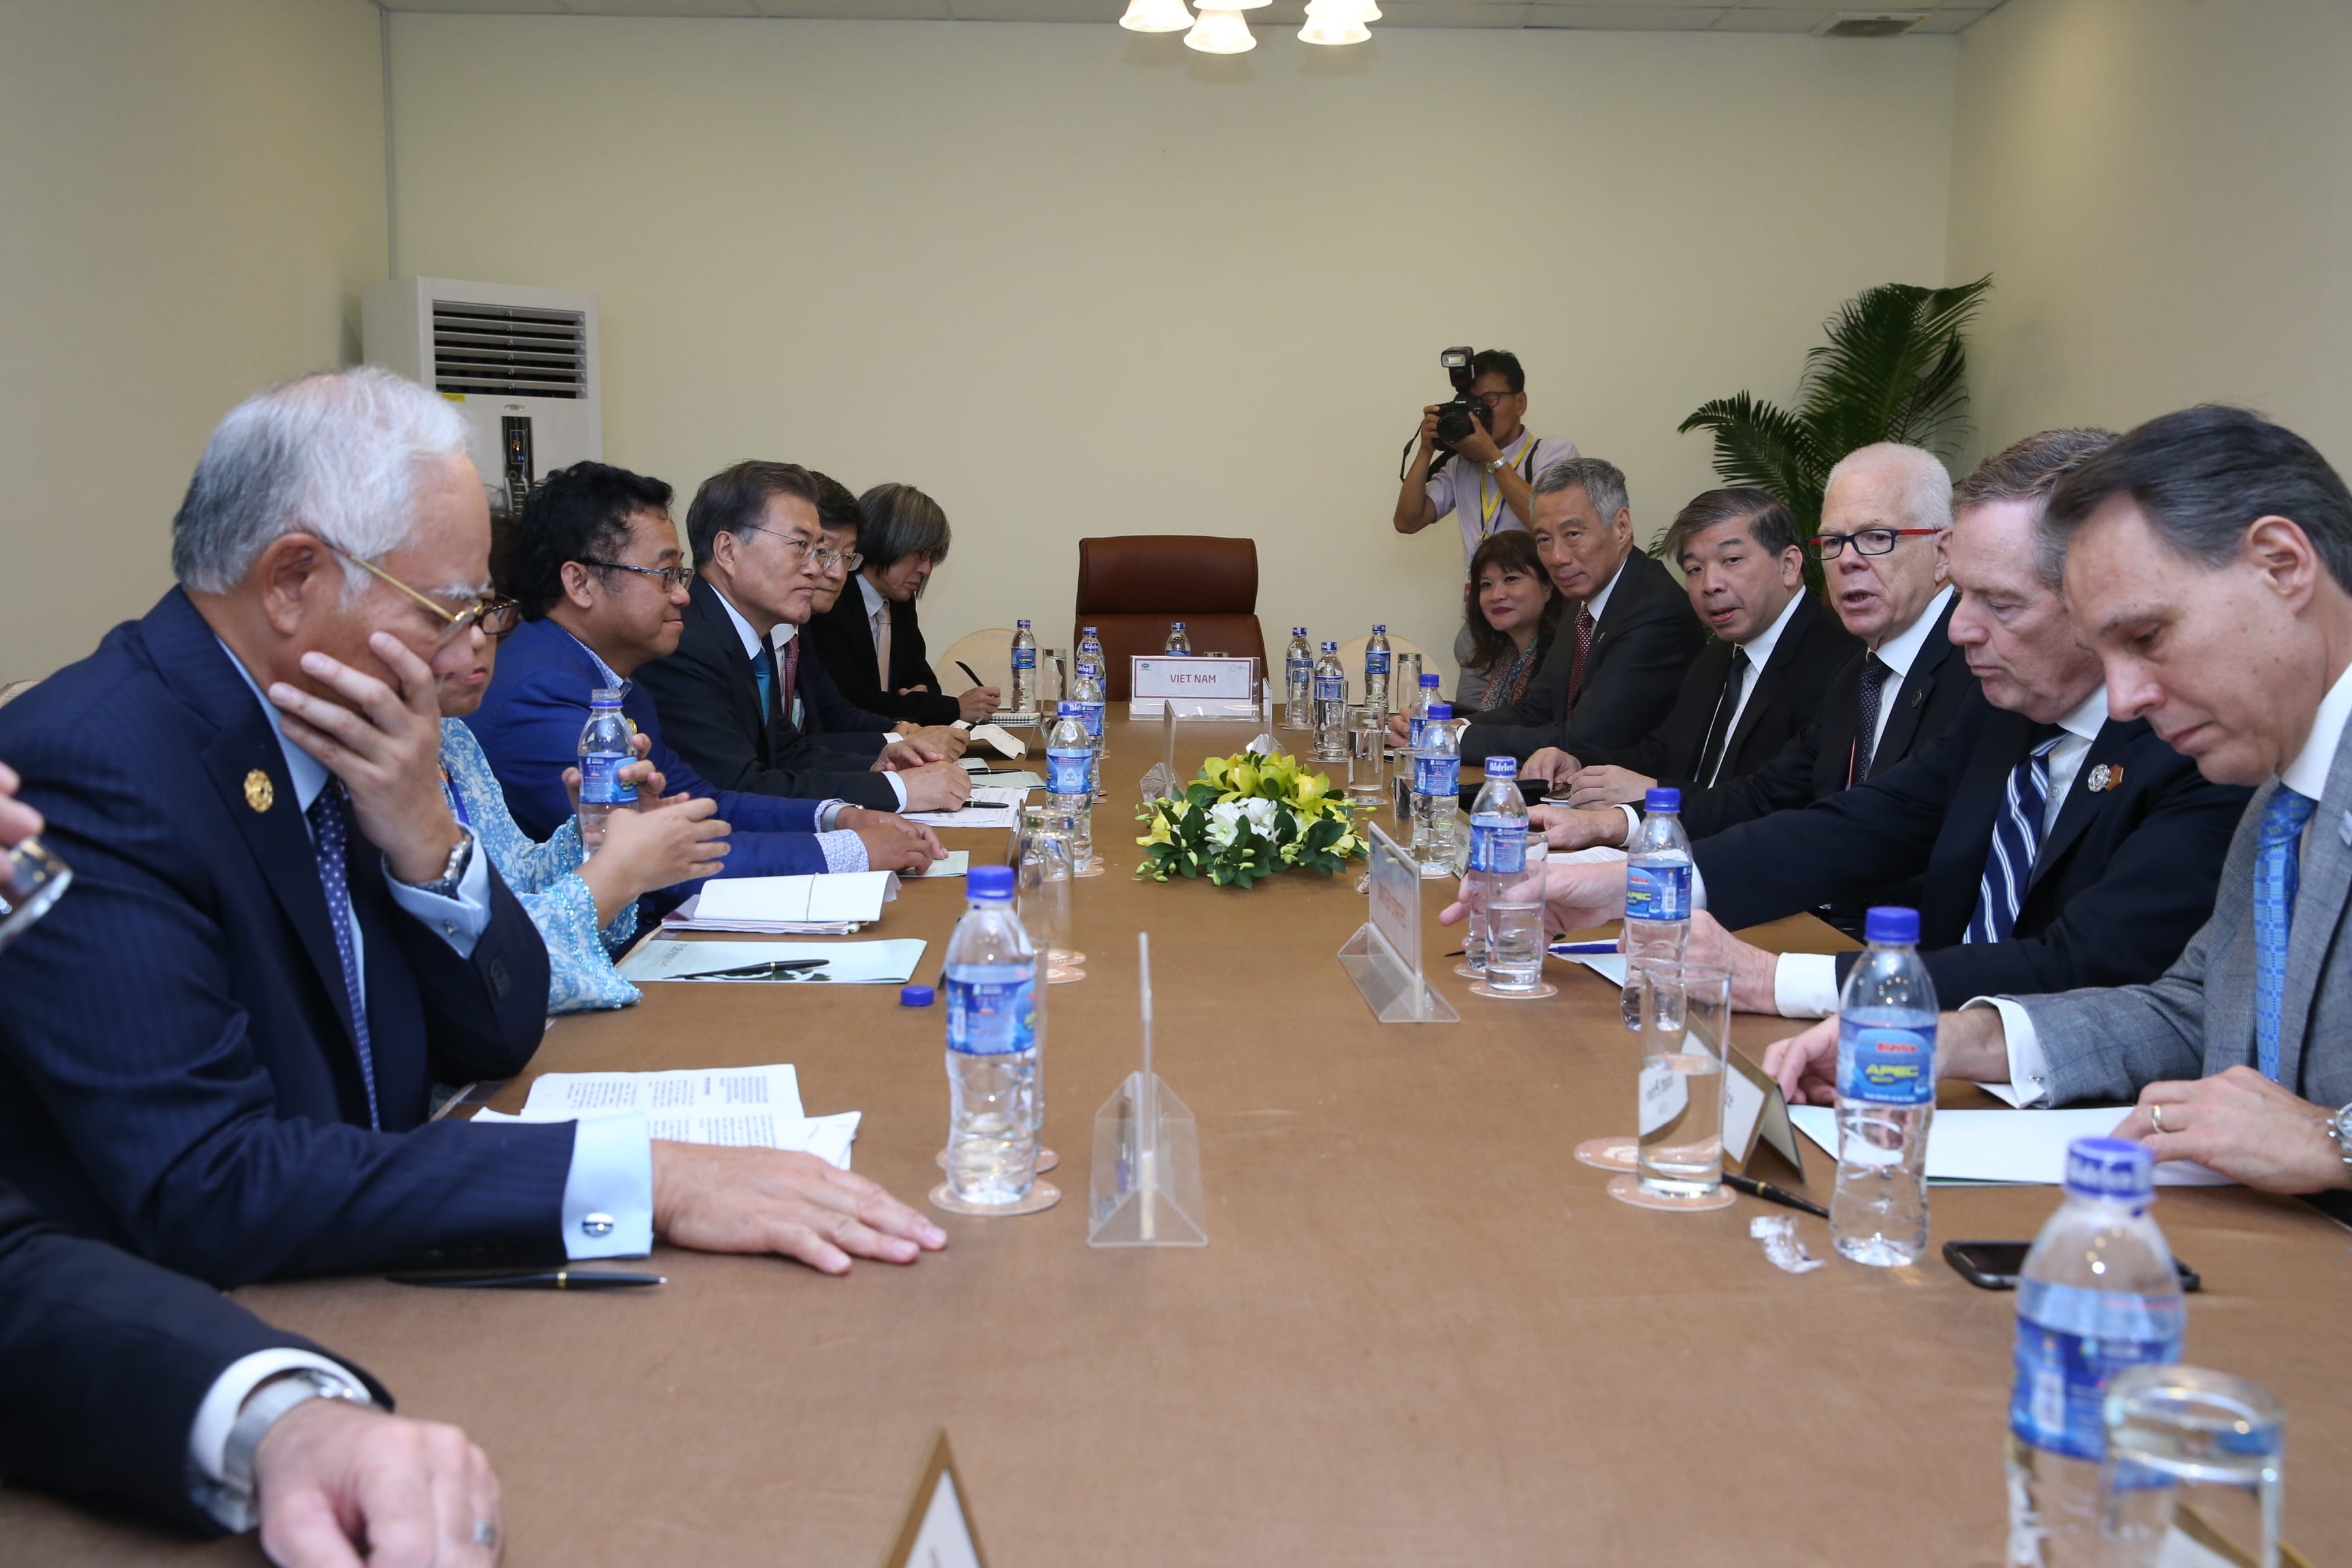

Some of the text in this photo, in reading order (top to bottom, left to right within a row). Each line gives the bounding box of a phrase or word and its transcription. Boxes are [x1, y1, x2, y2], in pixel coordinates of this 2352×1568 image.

[1170, 674, 1216, 684] VIET NAM
[1489, 762, 1514, 772] Bidrico
[1865, 1064, 1920, 1078] APEC
